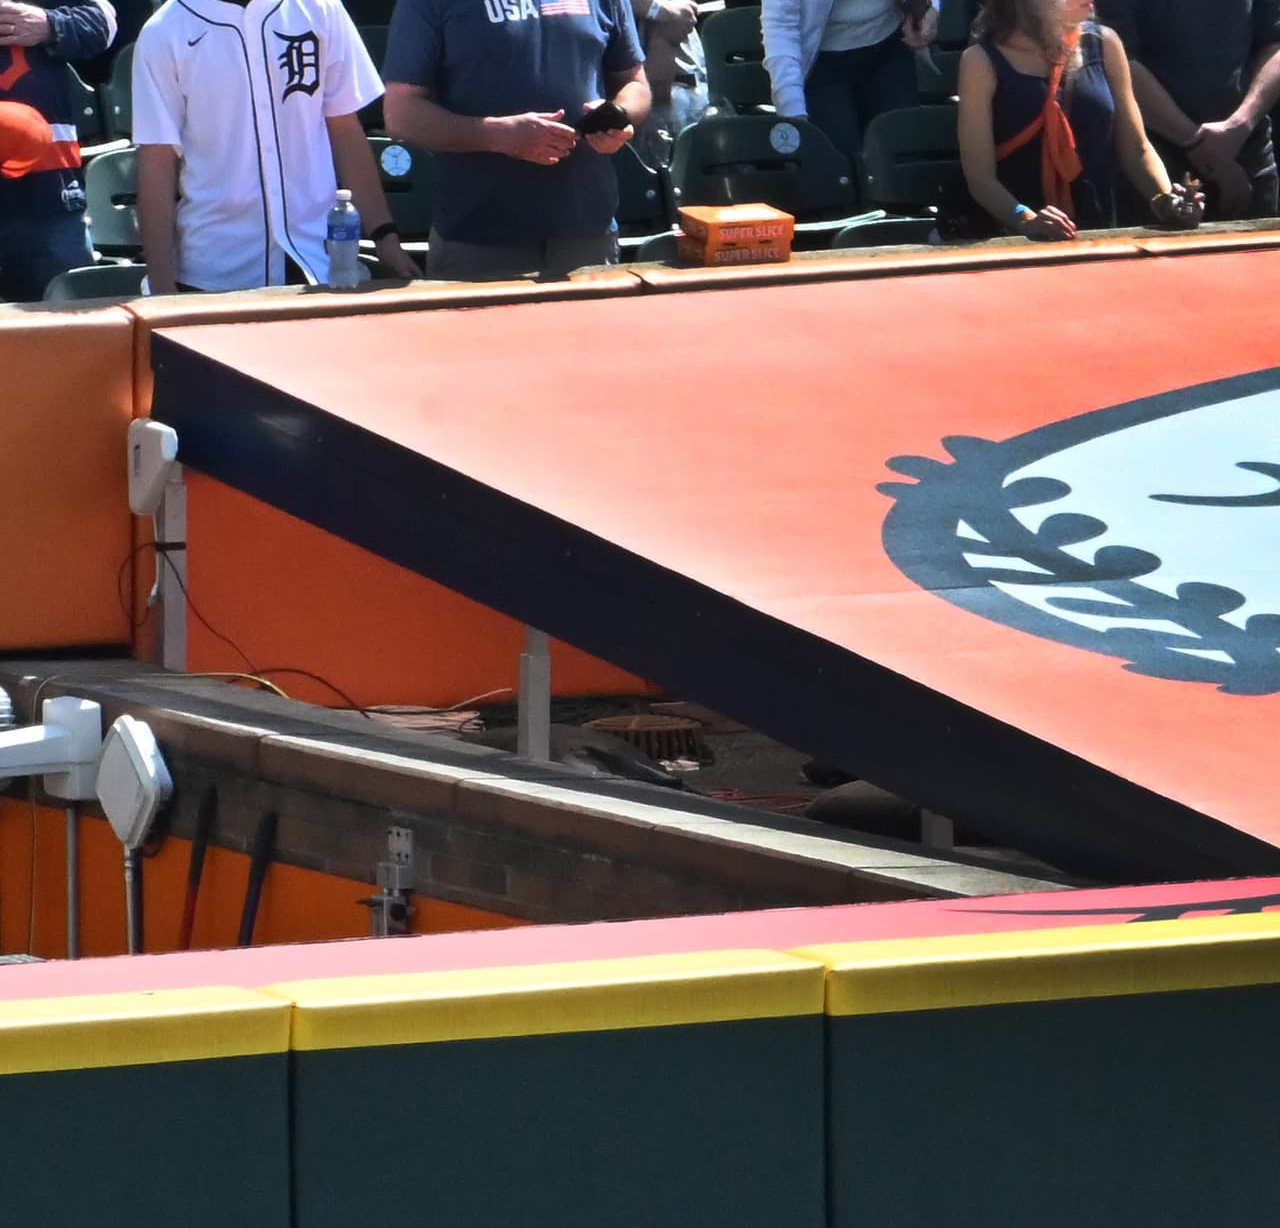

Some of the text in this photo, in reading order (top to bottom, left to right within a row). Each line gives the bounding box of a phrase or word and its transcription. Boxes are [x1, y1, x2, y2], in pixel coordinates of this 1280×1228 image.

[273, 31, 320, 104] D
[719, 224, 785, 240] SUPER SLICE
[714, 248, 751, 263] SUPER
